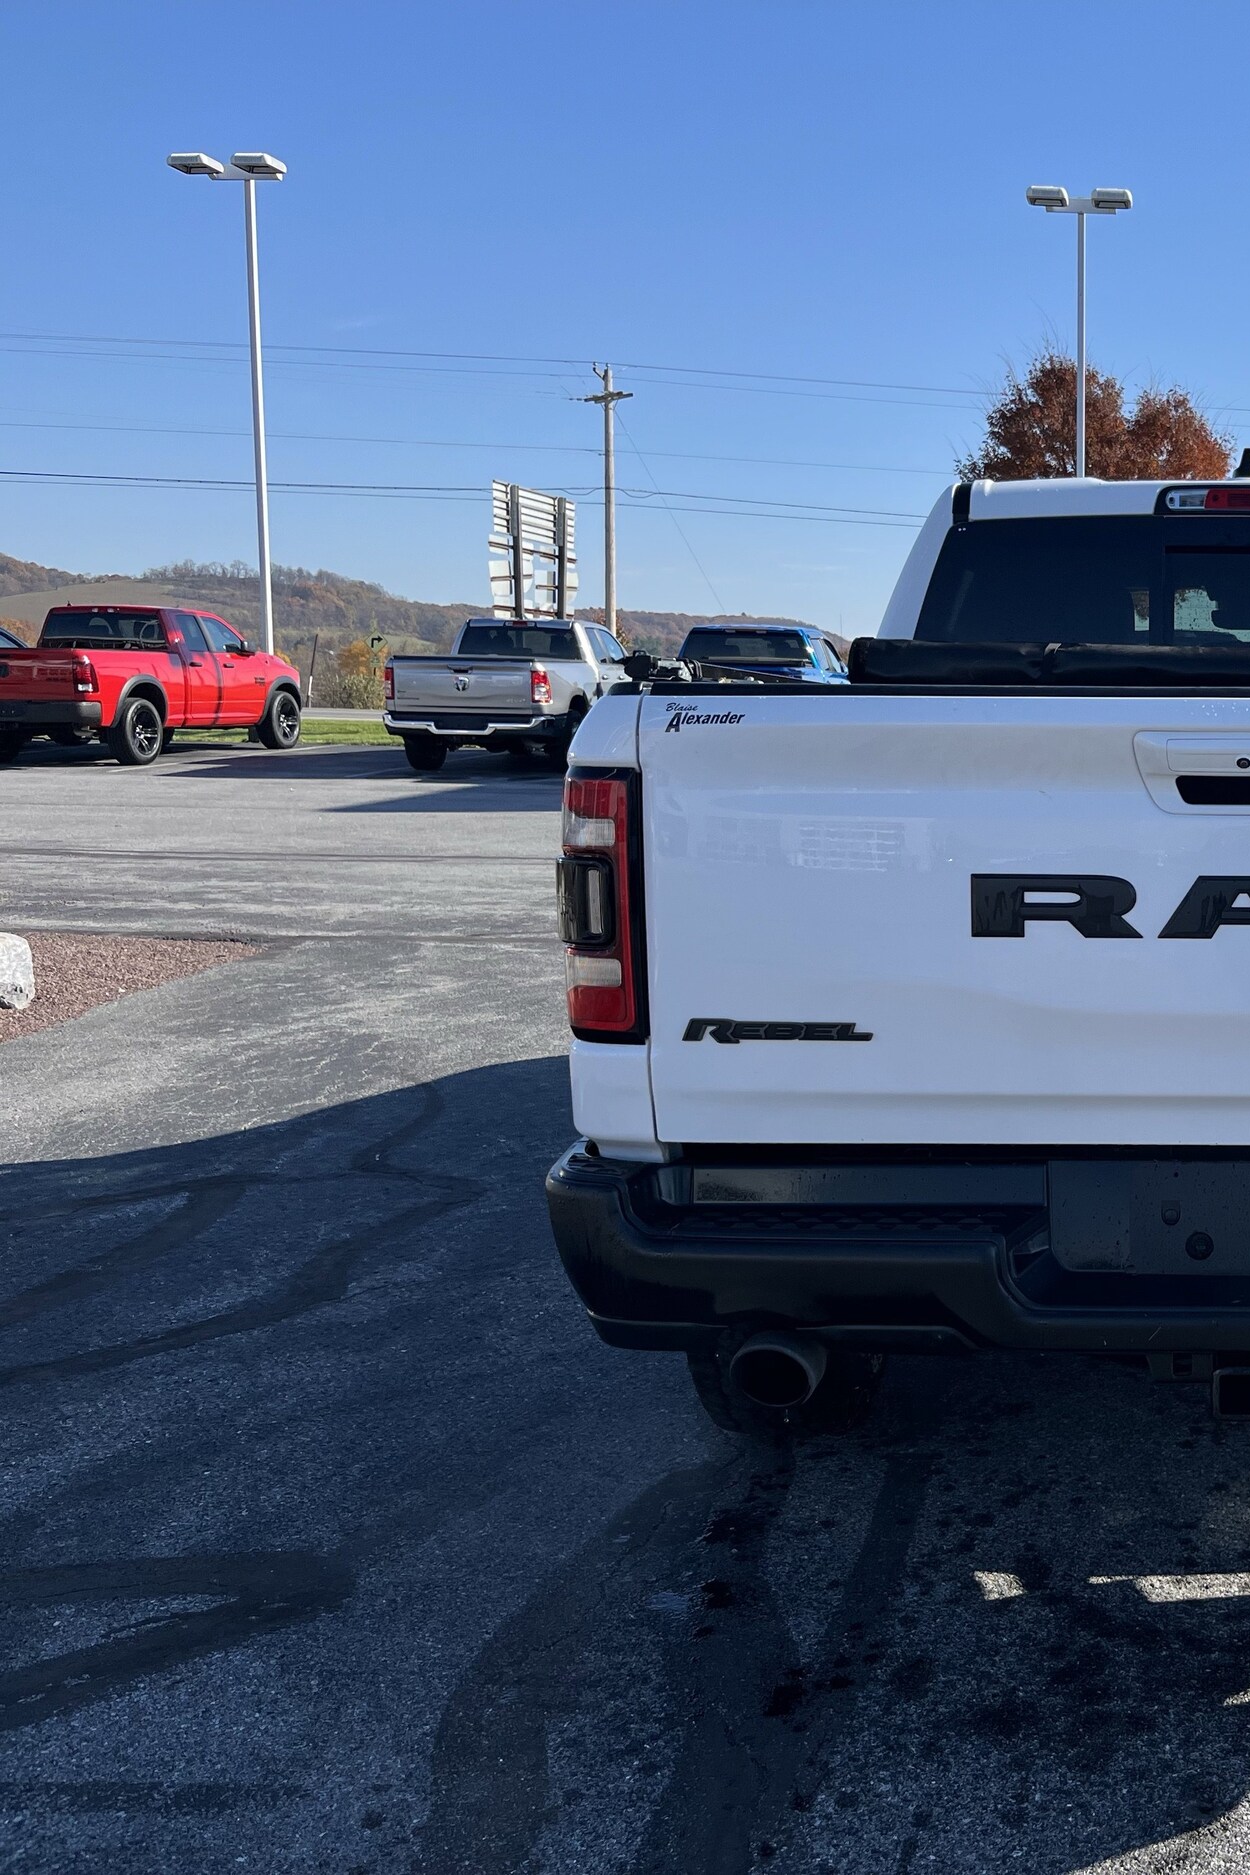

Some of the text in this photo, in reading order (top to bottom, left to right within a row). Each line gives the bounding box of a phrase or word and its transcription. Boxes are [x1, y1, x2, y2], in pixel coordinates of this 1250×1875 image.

[665, 702, 699, 712] Blaise
[664, 711, 746, 733] Alexander
[681, 1017, 874, 1044] REBEL
